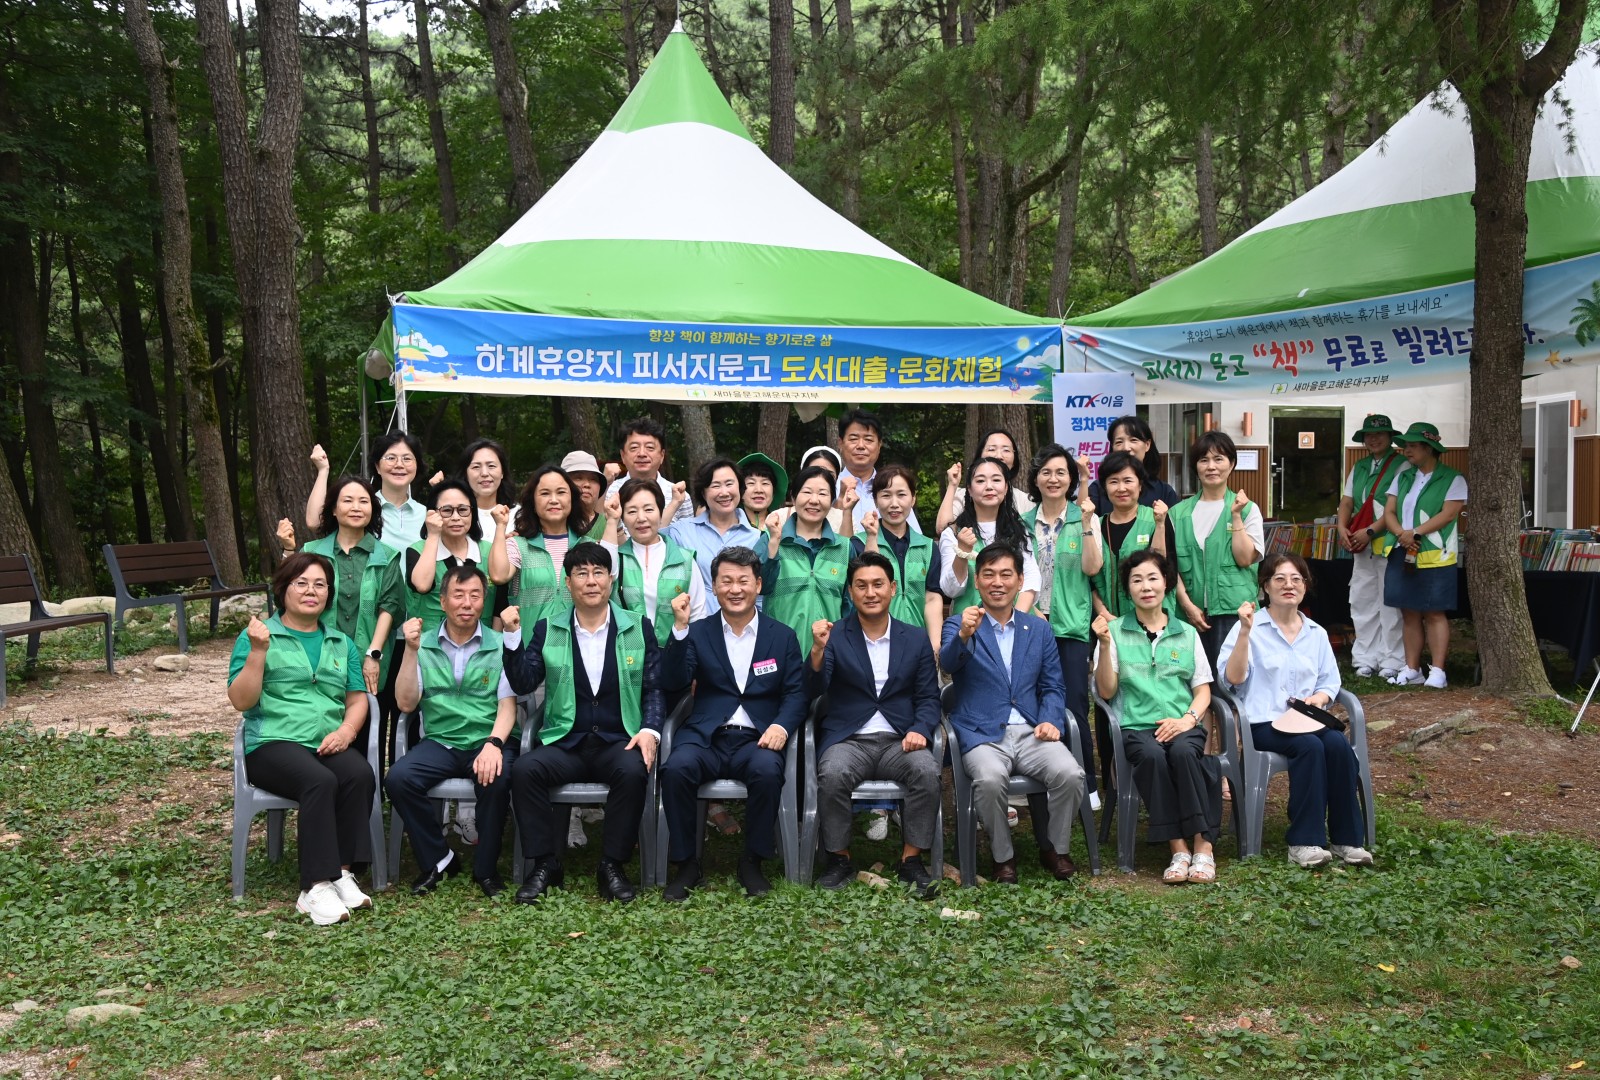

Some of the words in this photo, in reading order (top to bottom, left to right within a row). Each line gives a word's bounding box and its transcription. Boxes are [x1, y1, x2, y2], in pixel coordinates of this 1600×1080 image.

[1216, 326, 1236, 339] 도시
[1237, 319, 1288, 336] 해운대에서
[1288, 316, 1310, 330] 책과
[1311, 310, 1354, 328] 함께하는
[1357, 304, 1391, 322] 휴가를
[649, 328, 675, 343] 항상
[680, 330, 706, 344] 책이
[710, 331, 761, 345] 함께하는
[765, 332, 816, 347] 향기로운
[820, 334, 833, 347] 삶
[475, 343, 622, 379] 하계휴양지
[632, 351, 772, 382] 피서지문고
[1140, 358, 1202, 381] 피서지
[1209, 352, 1250, 382] 문고
[1323, 334, 1388, 373] 무료로
[713, 390, 820, 399] 새마을문고해운대구지부
[1293, 374, 1389, 392] 새마을문고해운대구지부
